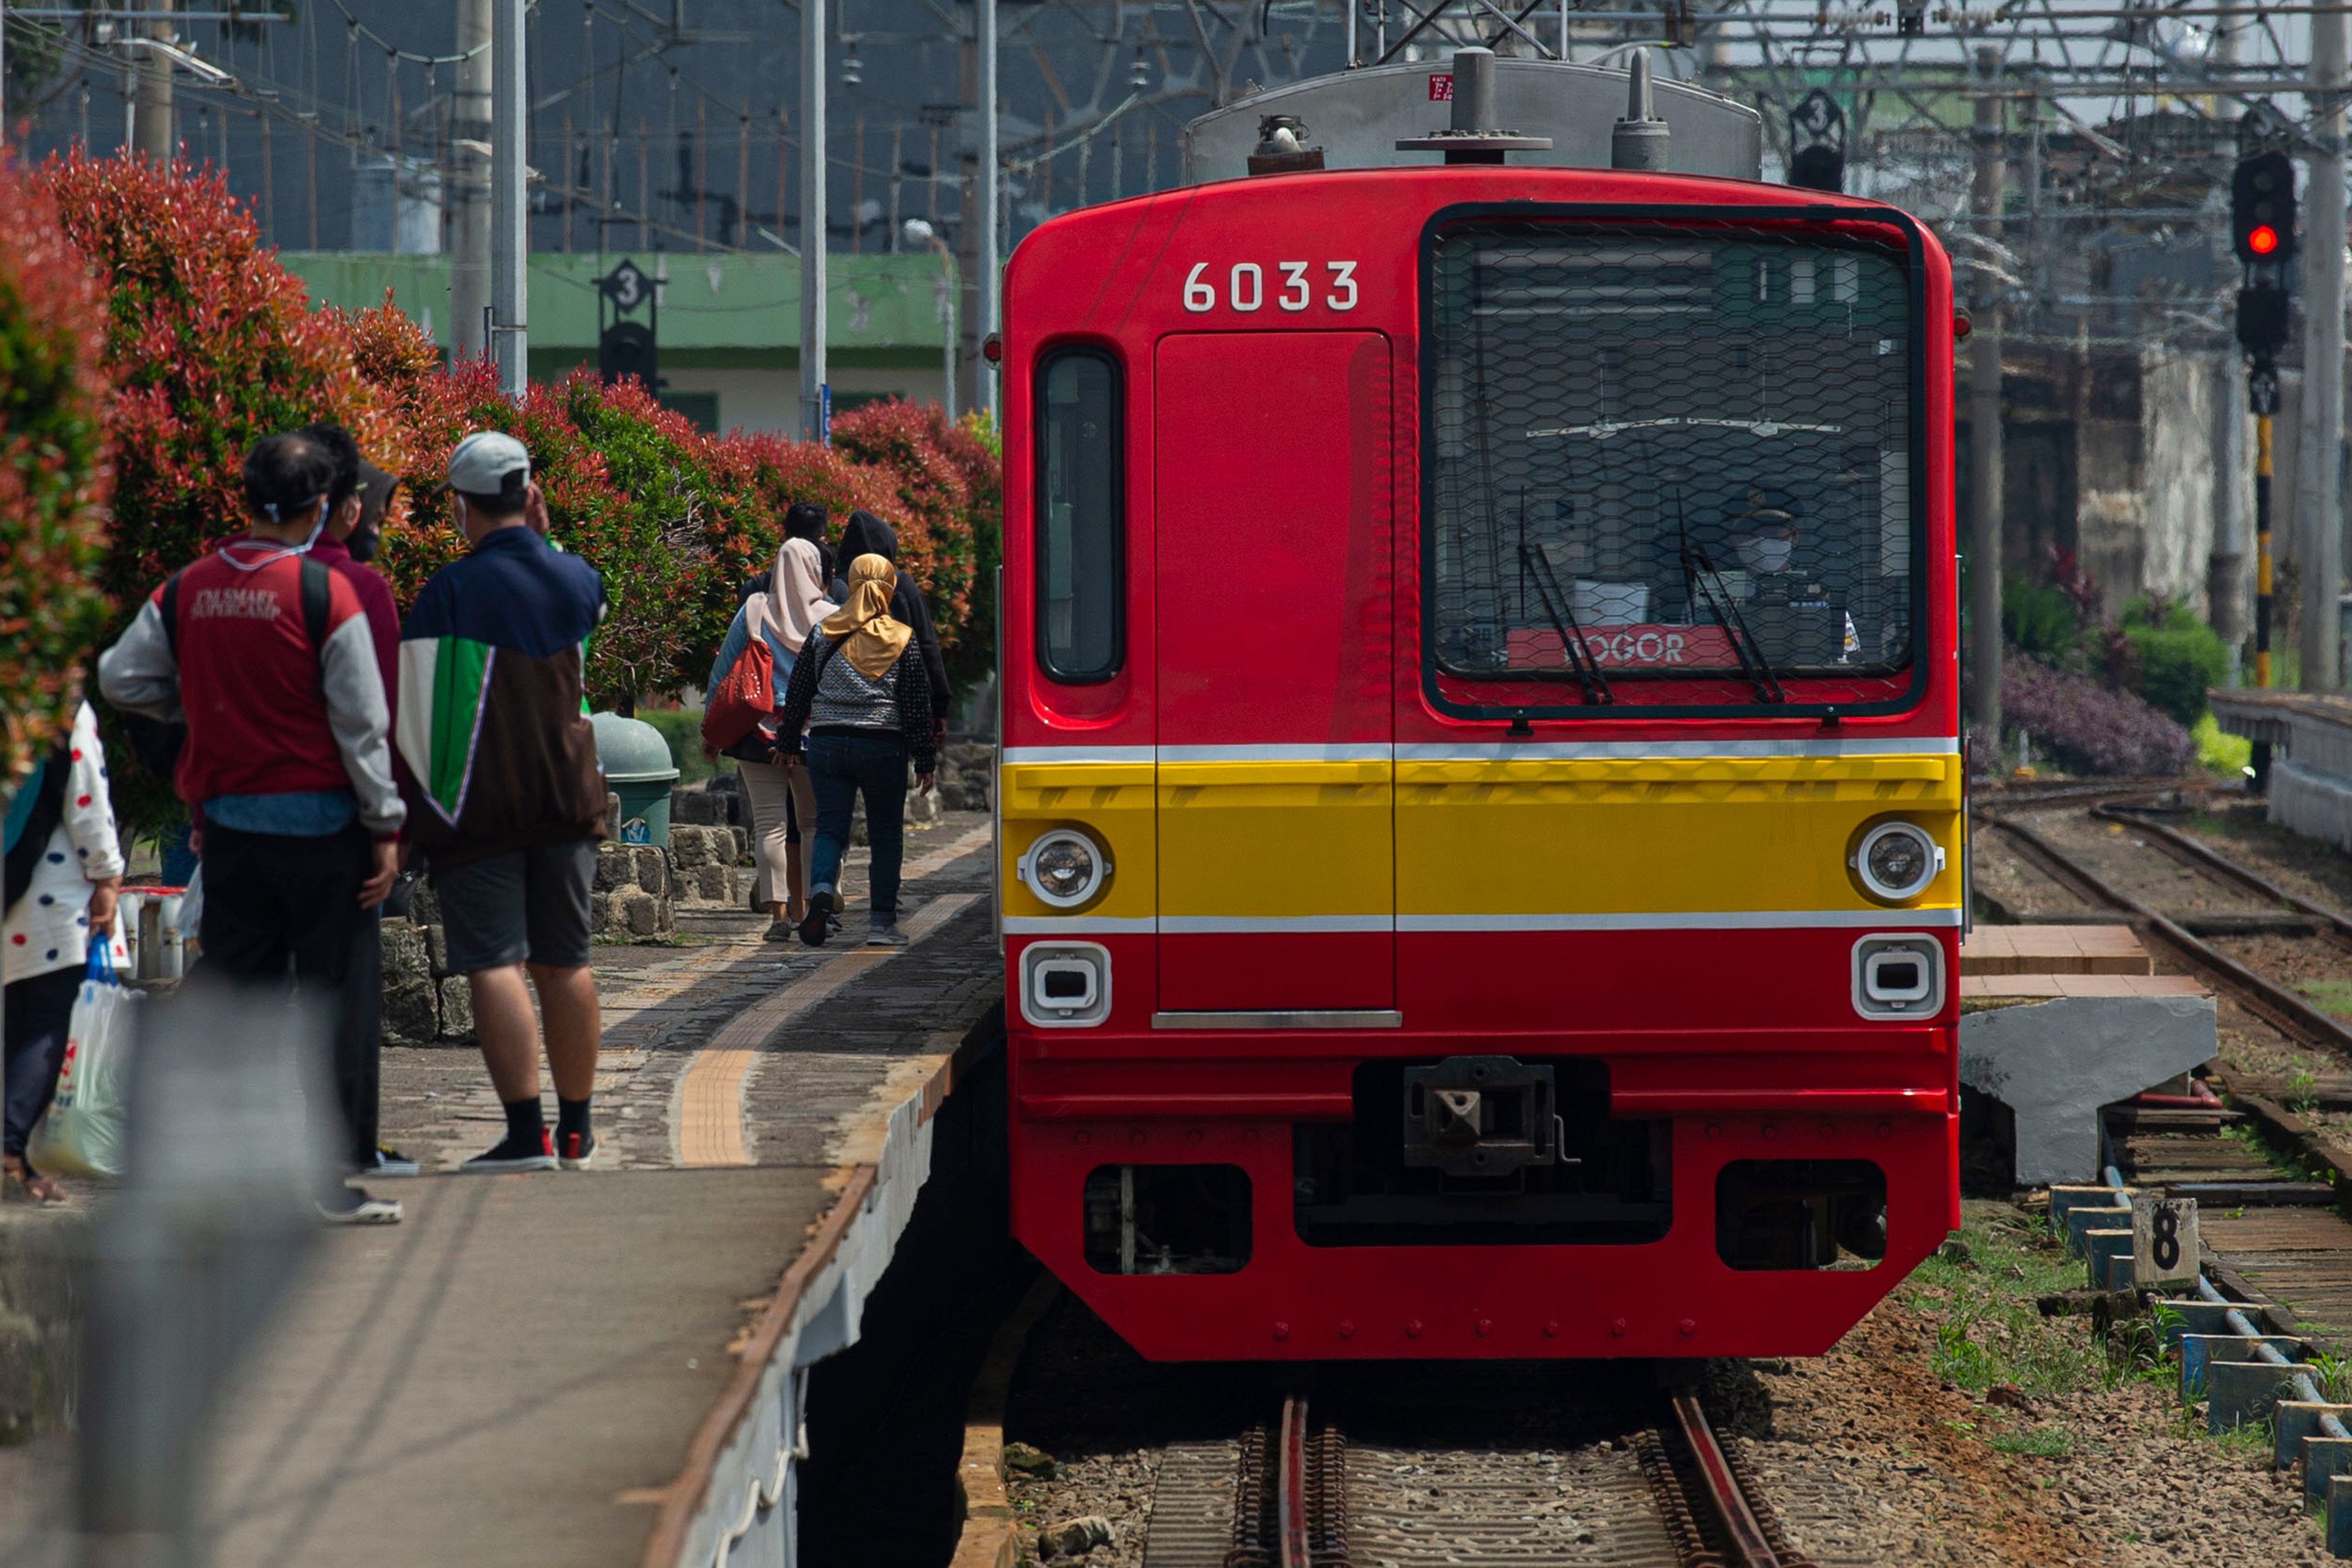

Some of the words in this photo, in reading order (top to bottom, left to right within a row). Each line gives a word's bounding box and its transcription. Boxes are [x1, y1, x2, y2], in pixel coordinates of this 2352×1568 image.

[1808, 97, 1829, 129] 3
[616, 268, 639, 305] 3
[1183, 261, 1358, 311] 6033
[222, 588, 279, 606] SMART
[2153, 1205, 2180, 1271] 8
